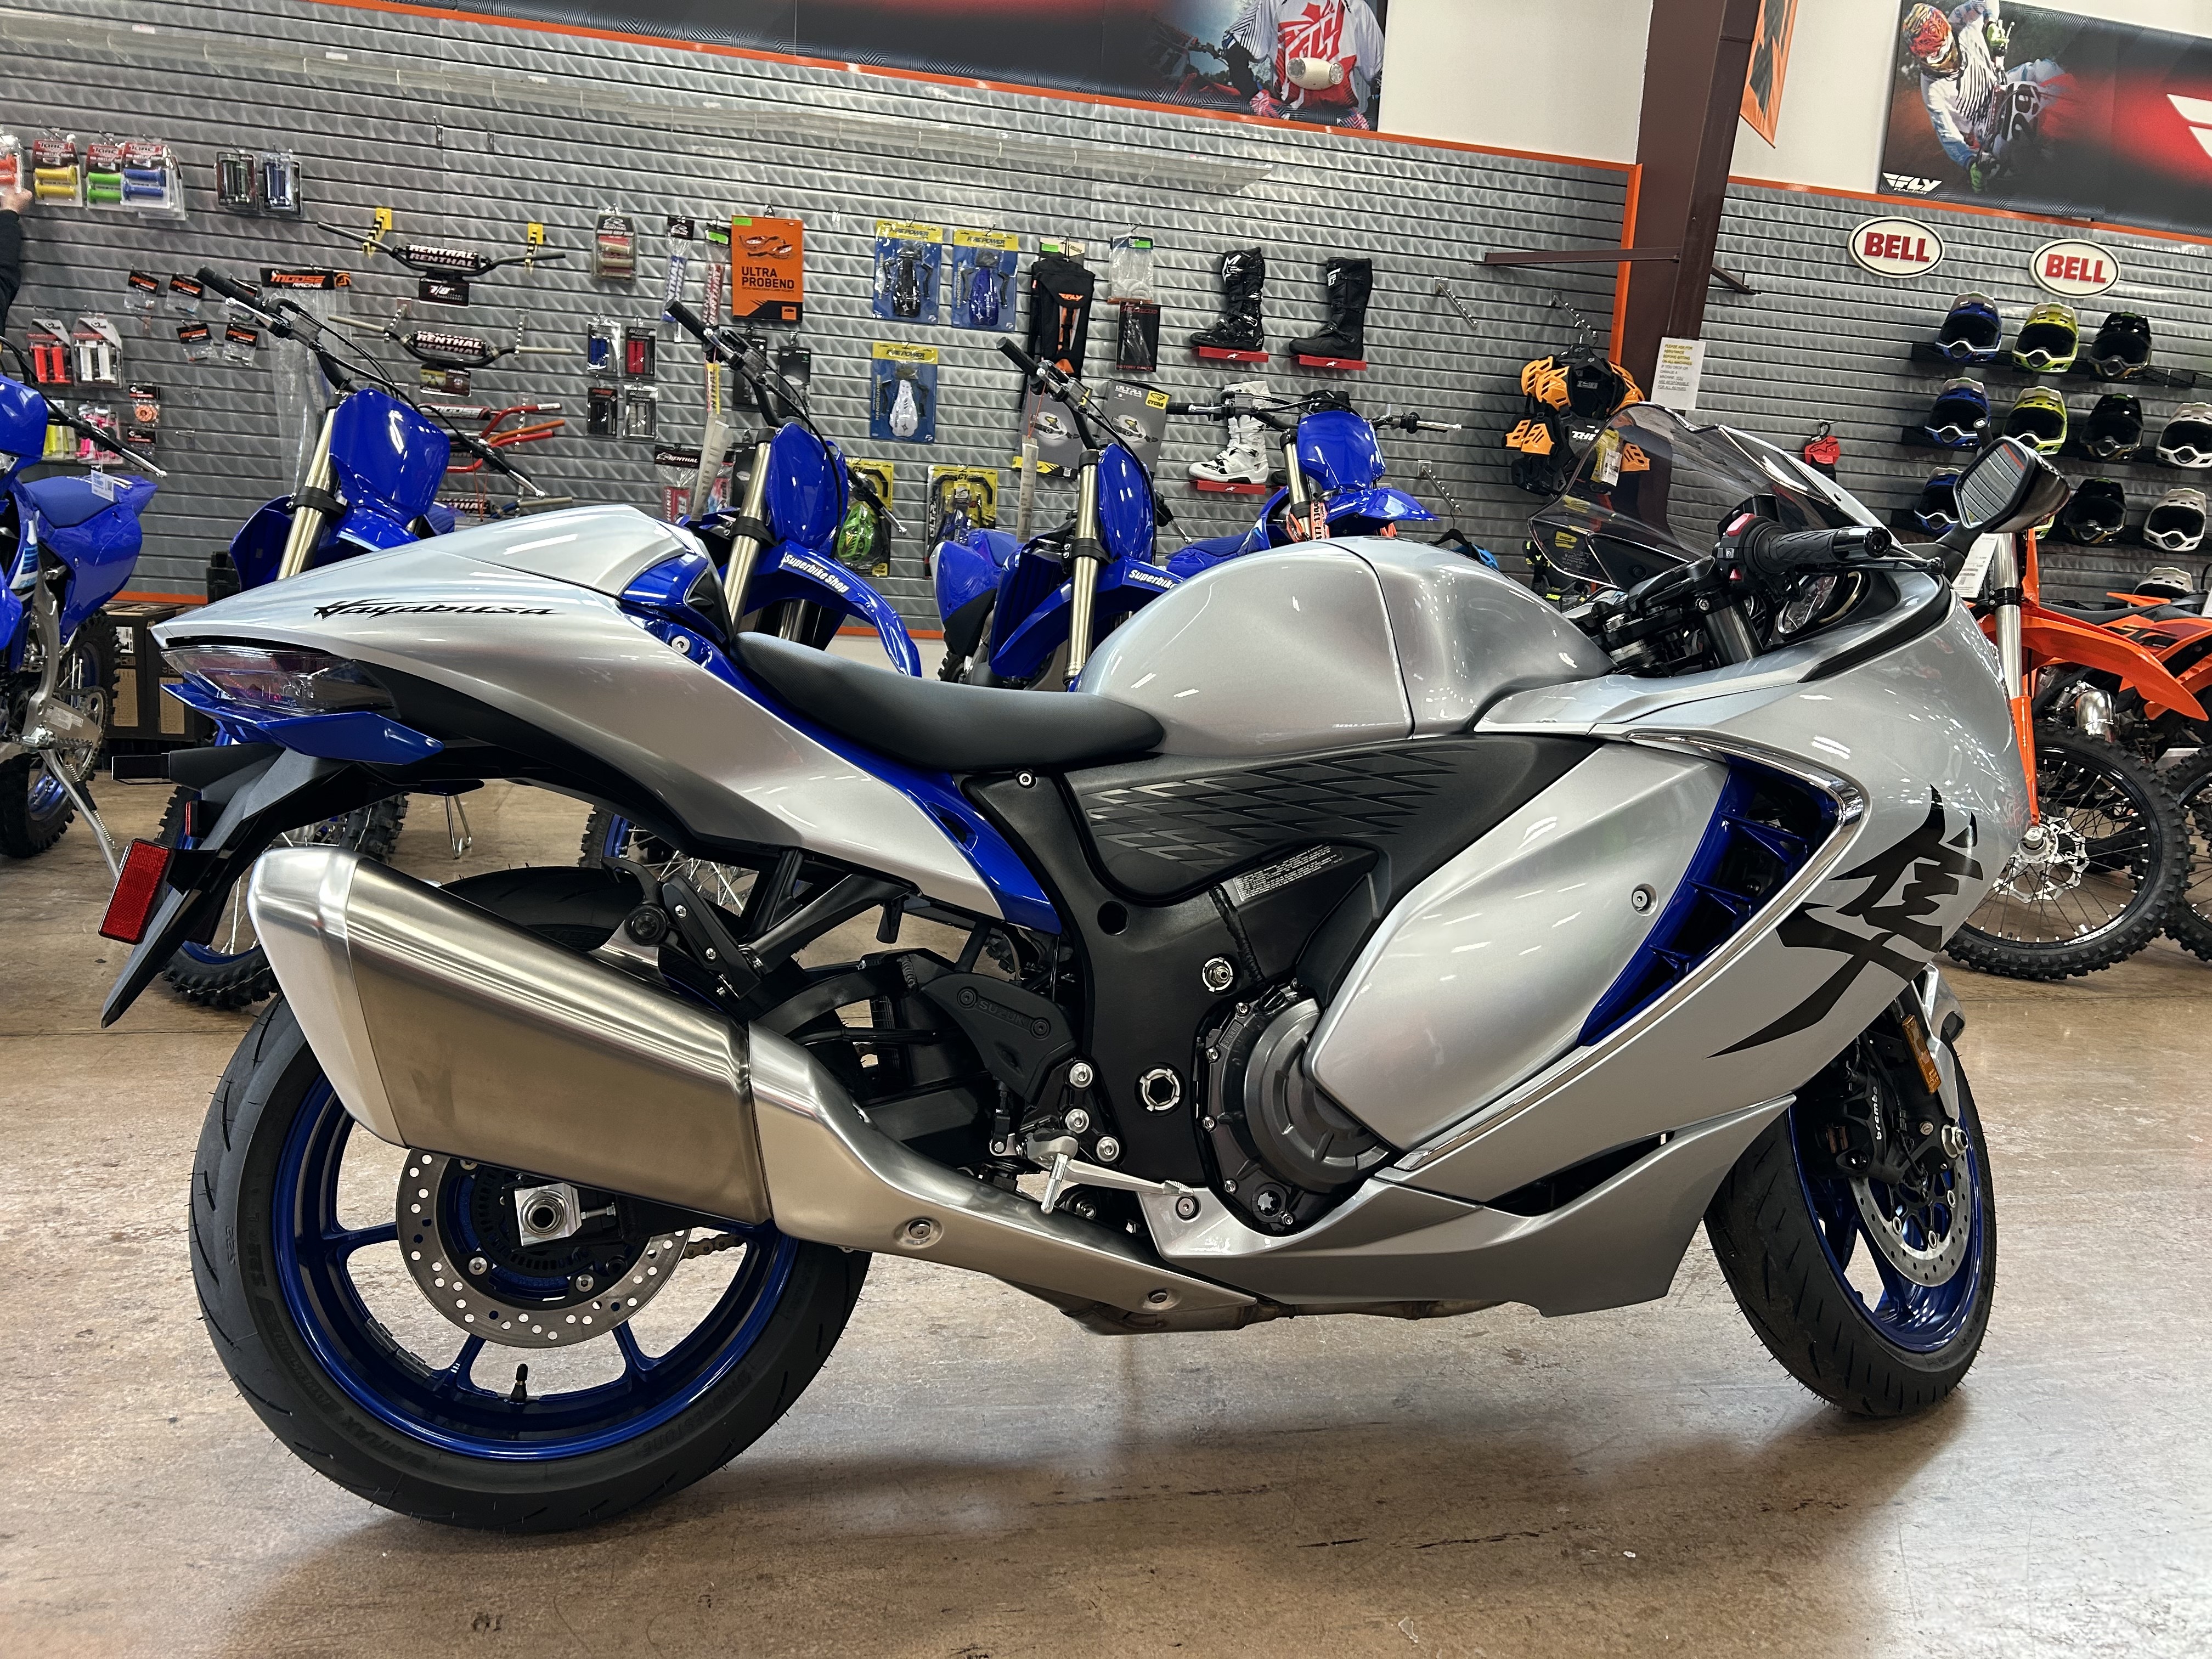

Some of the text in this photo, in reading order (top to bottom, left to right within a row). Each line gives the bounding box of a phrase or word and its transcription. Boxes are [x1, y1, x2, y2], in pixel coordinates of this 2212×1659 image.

[1883, 172, 1942, 192] FLY
[409, 244, 475, 259] RENTHAL
[1864, 232, 1931, 263] BELL
[409, 253, 475, 268] RENTHAL
[2045, 253, 2107, 284] BELL
[270, 274, 326, 284] MOOSE
[741, 266, 777, 278] ULTRA
[742, 276, 794, 289] PROBEND
[416, 333, 482, 349] RENTHAL
[1115, 385, 1142, 396] ULTRA
[1572, 431, 1596, 441] TH
[784, 555, 849, 593] Superbike Shop
[313, 597, 566, 620] Hayabusa
[1706, 784, 1983, 1059] 隼
[978, 1000, 1032, 1028] SUZUKI
[1871, 1086, 1882, 1141] brembo
